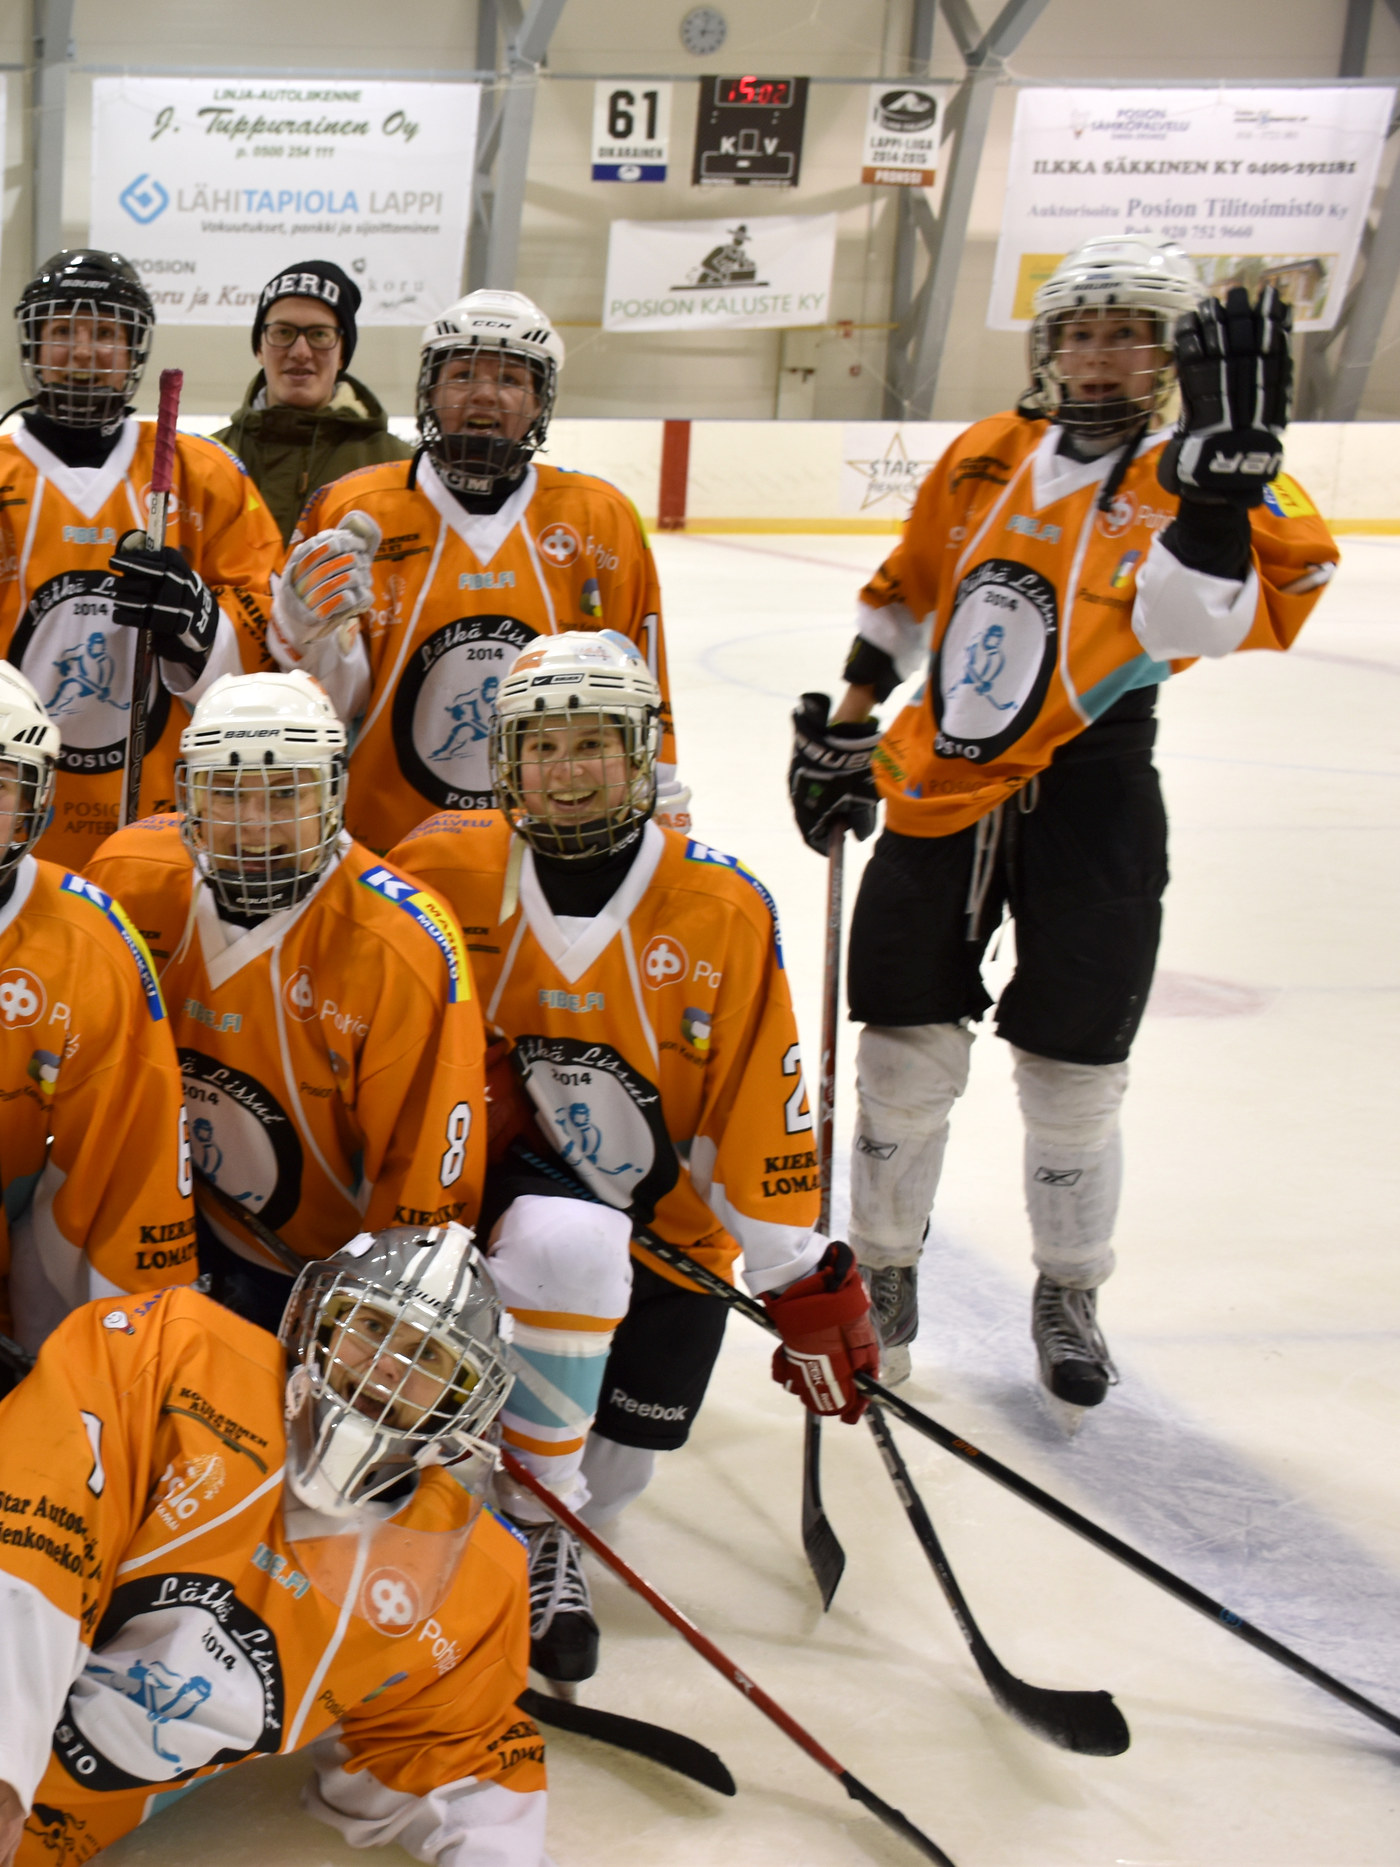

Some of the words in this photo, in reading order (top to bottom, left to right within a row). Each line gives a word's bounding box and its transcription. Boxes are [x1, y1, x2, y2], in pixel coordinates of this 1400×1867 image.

[213, 88, 363, 102] LINJA-AUTOLIIKENNE
[149, 105, 180, 141] J.
[197, 106, 370, 142] Tuppurainen
[381, 109, 420, 143] Oy
[607, 89, 658, 140] 61
[720, 136, 737, 155] K
[763, 137, 779, 155] V
[1032, 160, 1097, 176] ILKKA
[1101, 156, 1209, 176] SÄKKINEN
[1212, 160, 1245, 176] KY
[176, 182, 360, 214] LÄHITAPIOLA
[368, 190, 444, 215] LAPPI
[1127, 197, 1197, 218] Posion
[1204, 197, 1327, 218] Tilitoimisto
[201, 220, 288, 236] Vakuutukset,
[290, 220, 336, 237] pankki
[338, 221, 353, 237] ja
[355, 220, 440, 237] sijoittaminen
[261, 272, 342, 308] NERD
[610, 297, 695, 317] POSION
[701, 295, 793, 316] KALUSTE
[797, 293, 825, 312] KY
[471, 318, 512, 331] CCM
[73, 601, 109, 617] 2014
[466, 648, 504, 661] 2014
[223, 728, 281, 740] BAUER
[444, 792, 500, 810] POSI
[691, 840, 735, 866] K
[67, 873, 107, 908] K
[364, 868, 412, 900] K
[551, 1067, 592, 1087] 2014
[438, 1100, 473, 1189] 8
[763, 1152, 819, 1176] KIER
[609, 1387, 689, 1423] Reebok
[250, 1541, 311, 1599] IBE.FI
